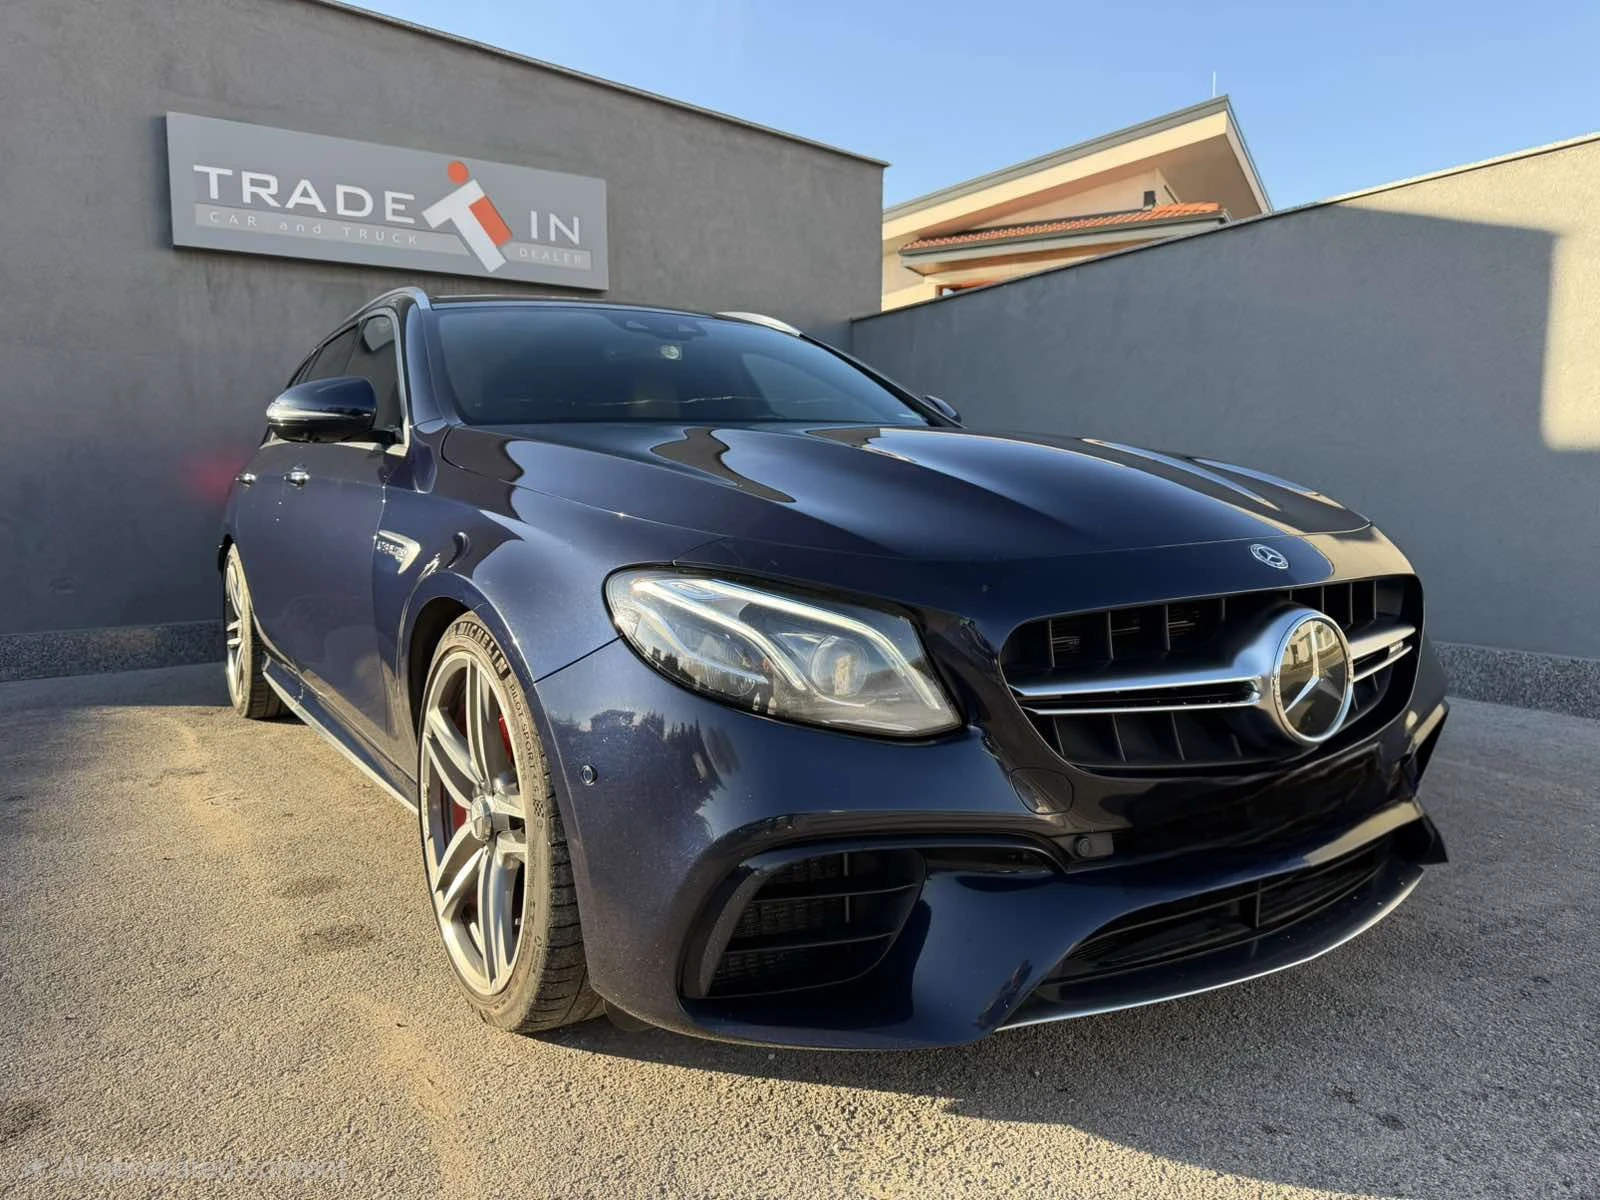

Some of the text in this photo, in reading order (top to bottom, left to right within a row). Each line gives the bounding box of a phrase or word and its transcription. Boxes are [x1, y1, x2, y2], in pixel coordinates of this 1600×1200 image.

[192, 163, 416, 224] TRADE
[530, 209, 581, 246] IN
[209, 210, 584, 266] CAR and TRUCK DEALER
[456, 621, 509, 676] MICHELIN
[509, 684, 524, 717] PILOT
[522, 723, 536, 769] SPORT
